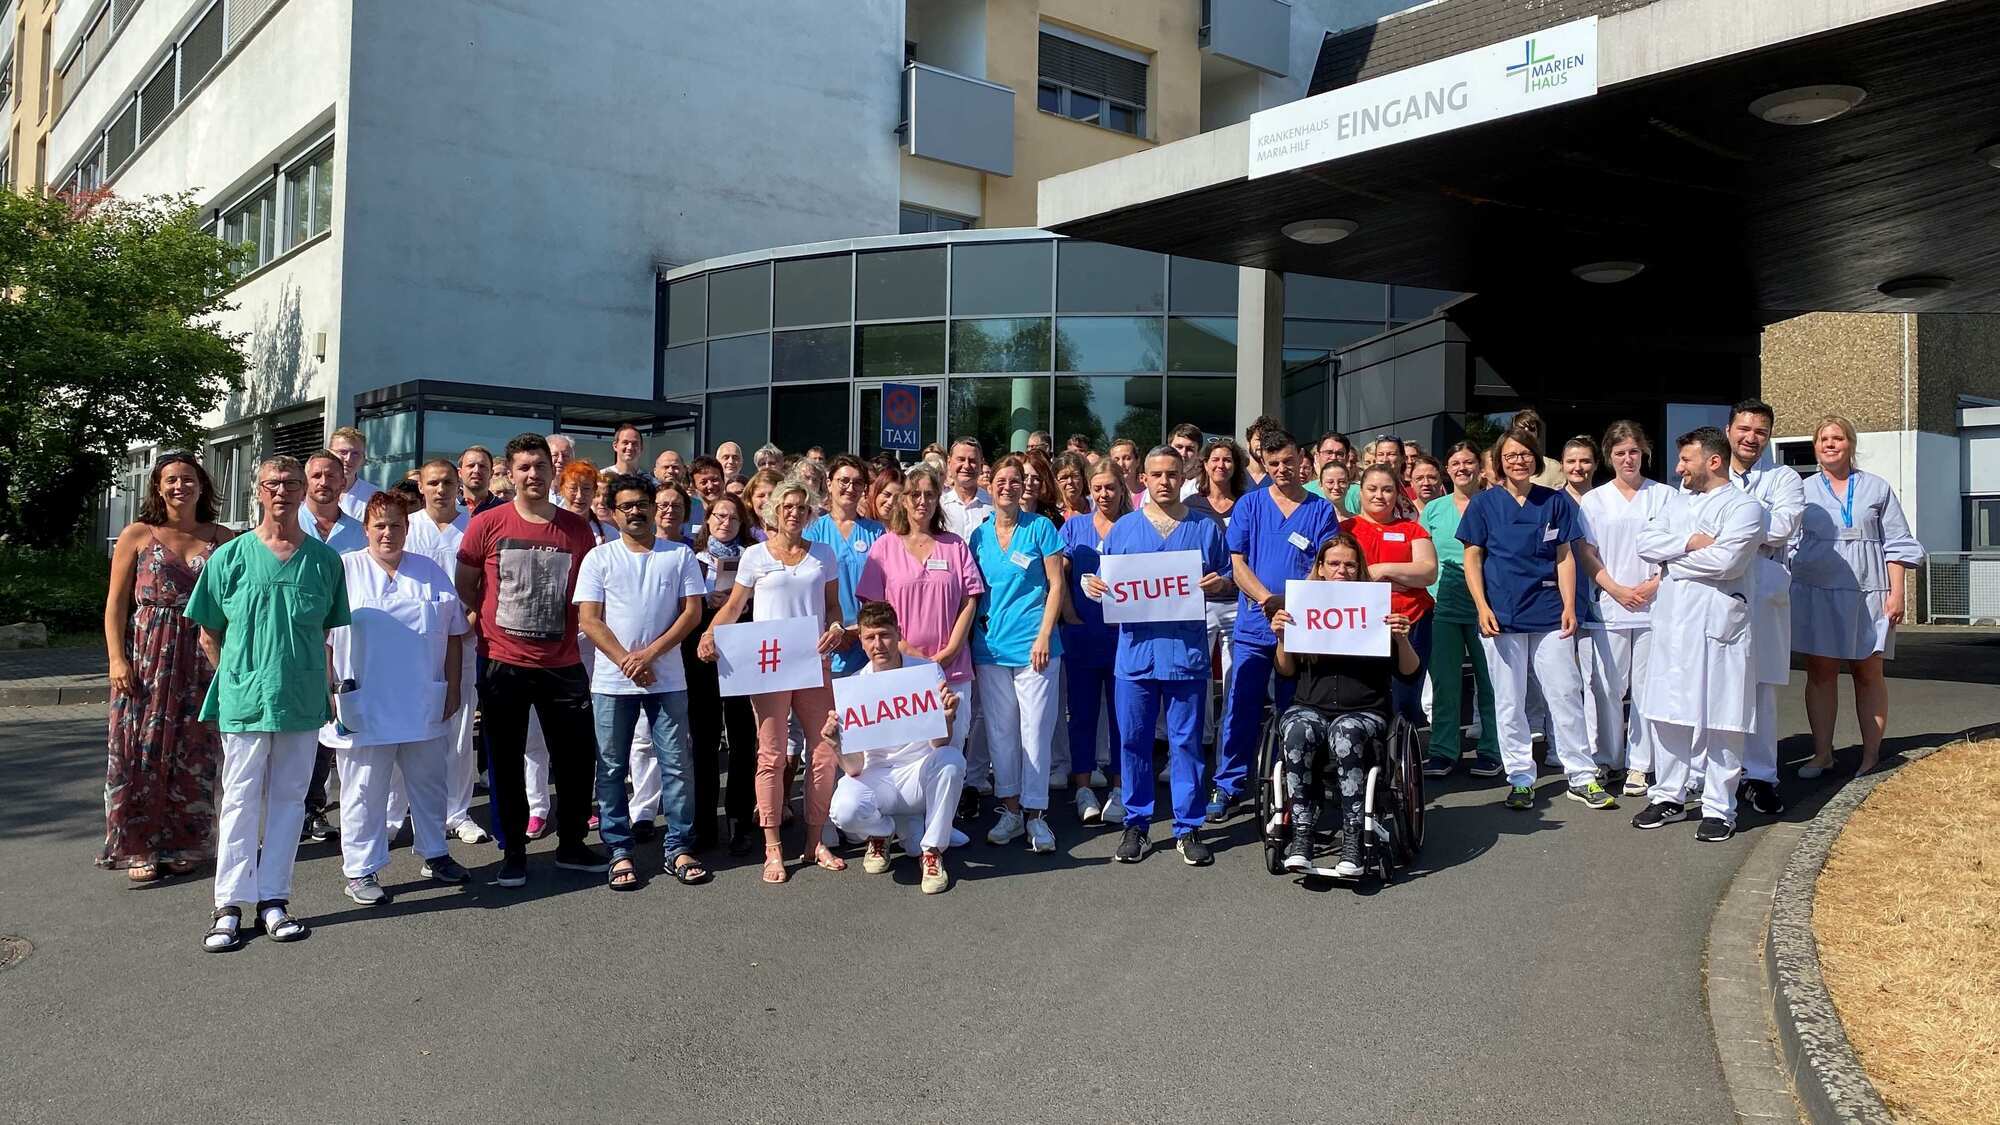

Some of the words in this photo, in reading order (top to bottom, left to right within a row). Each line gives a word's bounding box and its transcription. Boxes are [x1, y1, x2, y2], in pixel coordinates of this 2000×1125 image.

[1532, 53, 1584, 78] MARIEN
[1532, 72, 1568, 92] HAUS
[1337, 81, 1469, 141] EINGANG
[1257, 118, 1329, 148] KRANKENHAUS
[1256, 144, 1289, 163] MARIA
[1289, 139, 1312, 155] HILF
[885, 428, 917, 445] TAXI
[1114, 575, 1190, 603] STUFE
[1306, 606, 1367, 630] ROT!
[758, 639, 781, 674] #
[844, 690, 938, 731] ALARM
